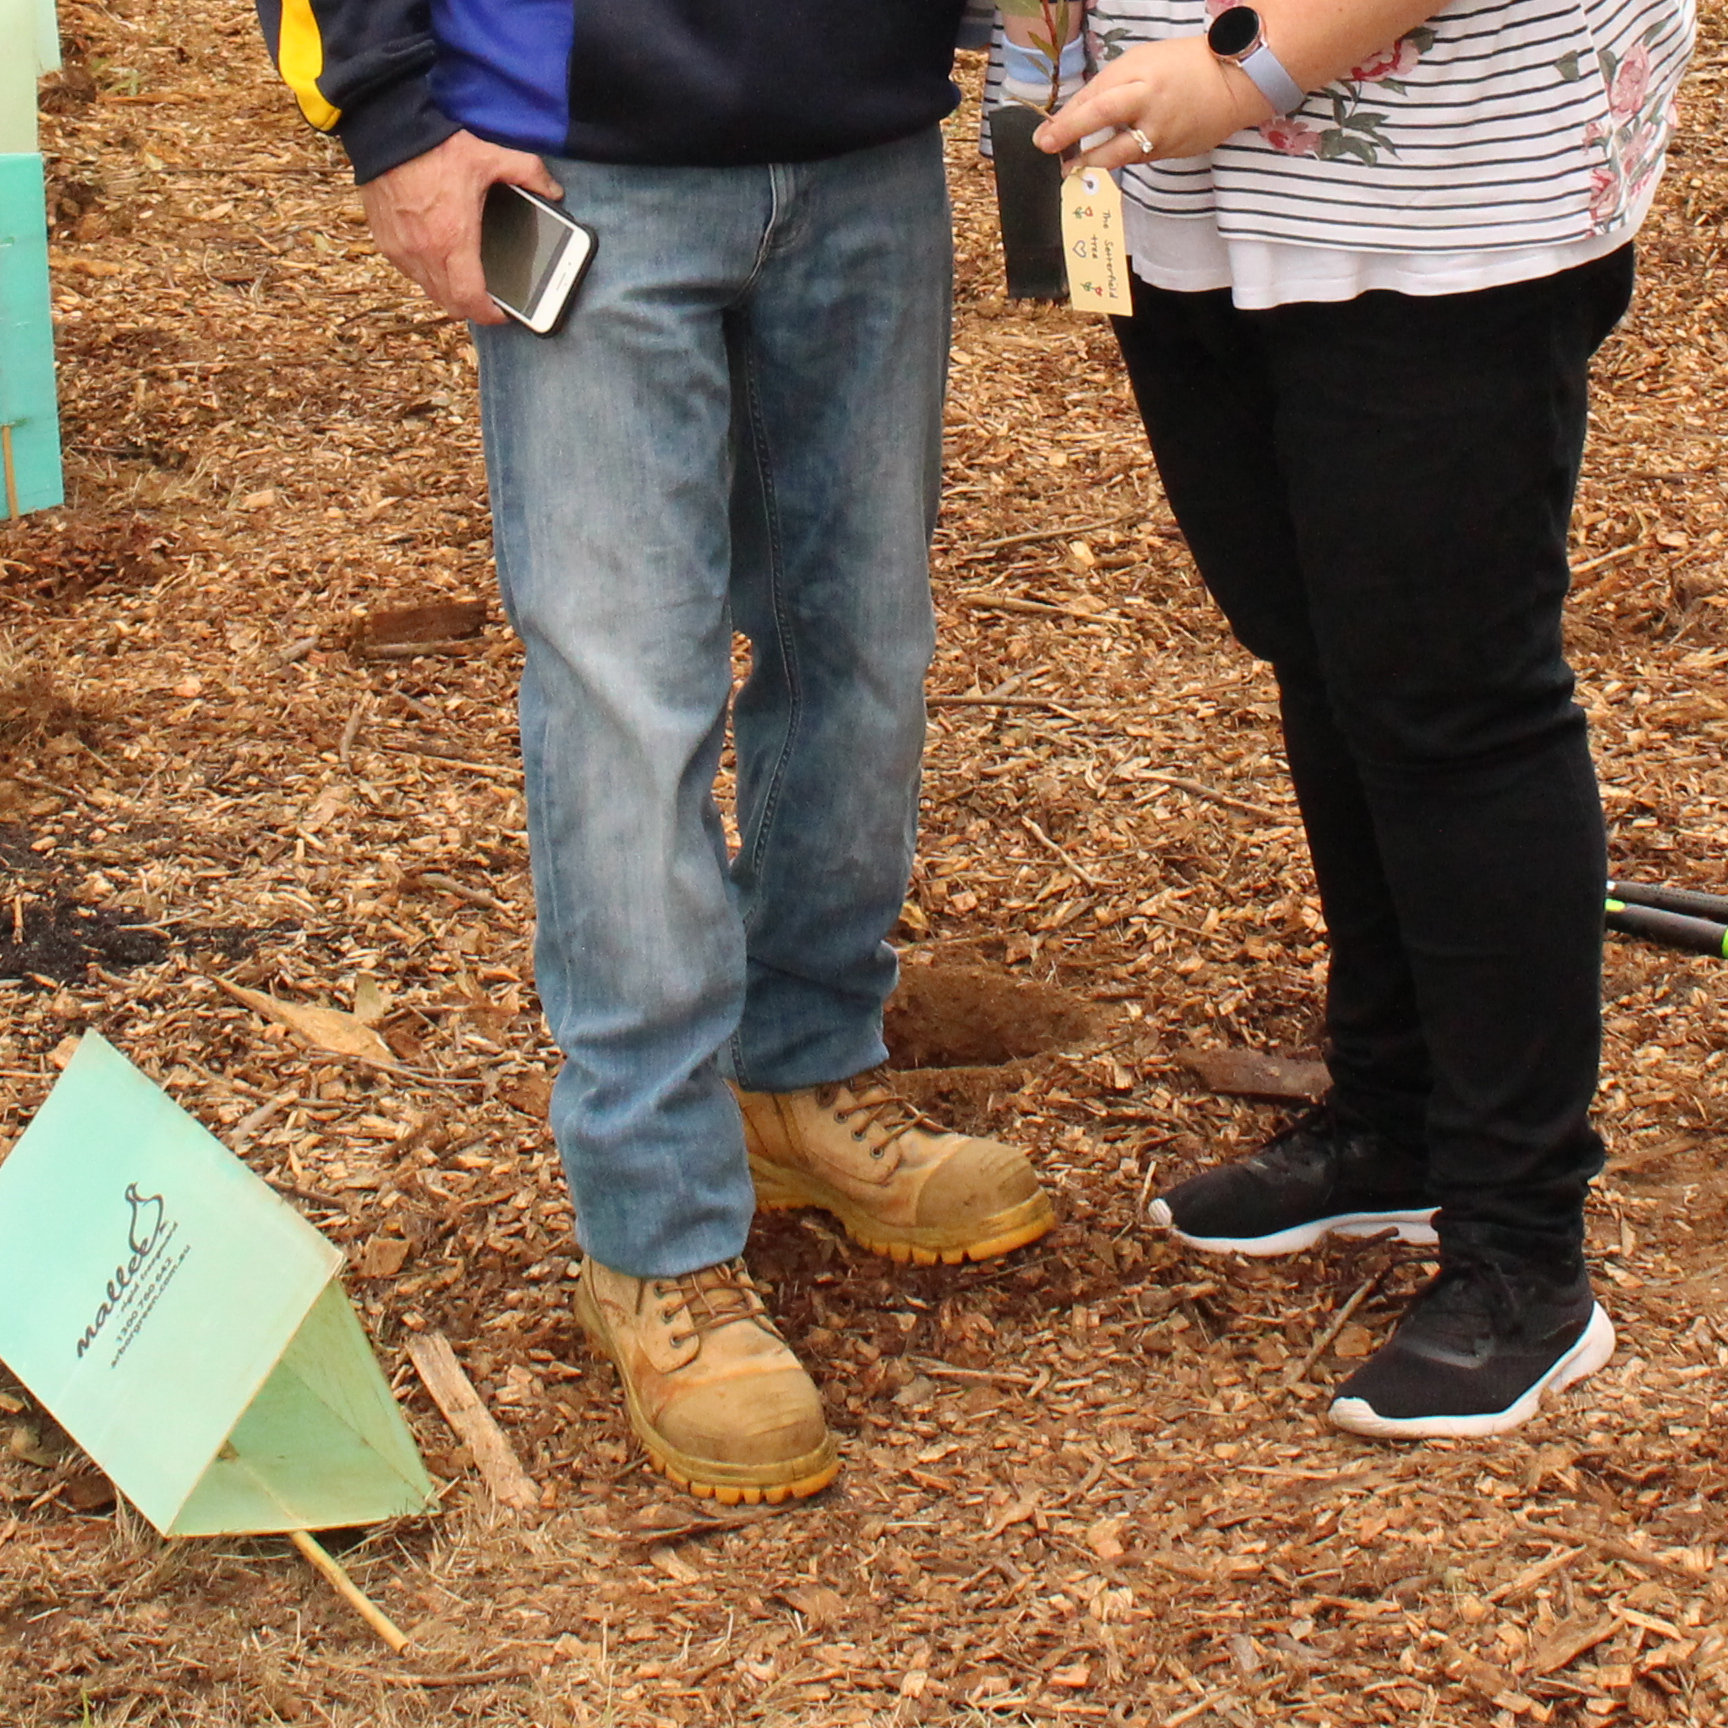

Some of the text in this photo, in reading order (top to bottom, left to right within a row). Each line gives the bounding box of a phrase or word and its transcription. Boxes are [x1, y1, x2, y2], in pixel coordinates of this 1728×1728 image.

[1103, 209, 1111, 229] The
[1091, 234, 1099, 260] tree
[76, 1237, 149, 1358] mallee
